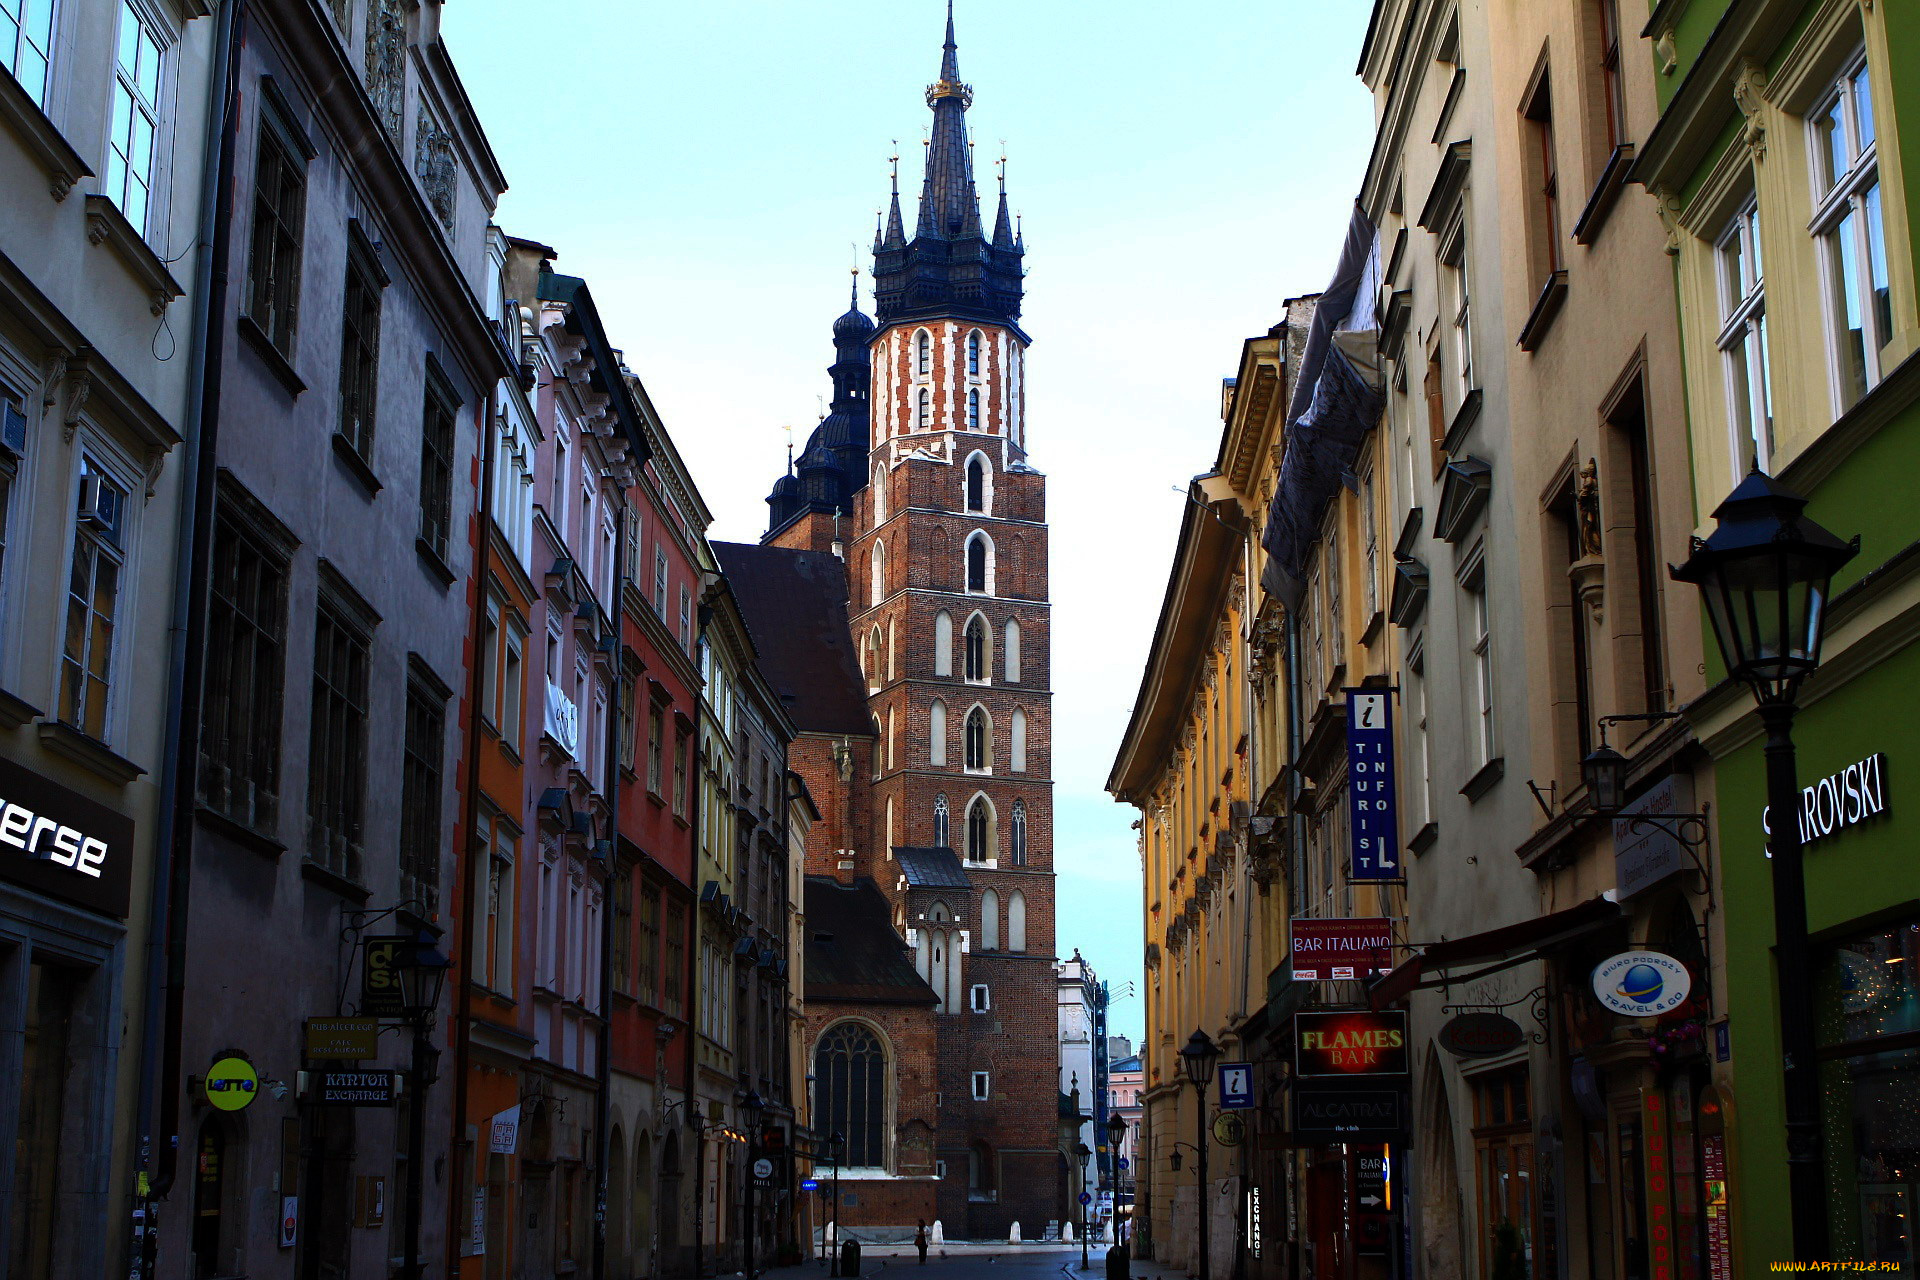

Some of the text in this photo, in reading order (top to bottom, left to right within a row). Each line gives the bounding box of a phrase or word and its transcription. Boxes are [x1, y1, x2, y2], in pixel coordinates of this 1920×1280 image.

[1374, 743, 1387, 811] INFO
[1356, 743, 1371, 869] TOURIST
[1762, 753, 1884, 859] SROVSKI
[0, 798, 108, 879] erse
[1294, 936, 1391, 952] BAR ITALIANO
[1602, 959, 1630, 977] BIURO
[1605, 993, 1652, 1013] TRAVEL
[1667, 992, 1683, 1006] GO
[1301, 1030, 1403, 1050] FLAMES
[1451, 1025, 1515, 1045] Kebab
[1331, 1049, 1376, 1065] BAR
[208, 1079, 256, 1092] LOTTO
[326, 1073, 389, 1087] KANTOR
[325, 1089, 389, 1102] EXCHANGE
[1303, 1102, 1393, 1118] ALCATRAZ
[1647, 1095, 1665, 1192] BIURO
[1360, 1158, 1381, 1170] BAR
[1253, 1187, 1261, 1259] EXCHANGE
